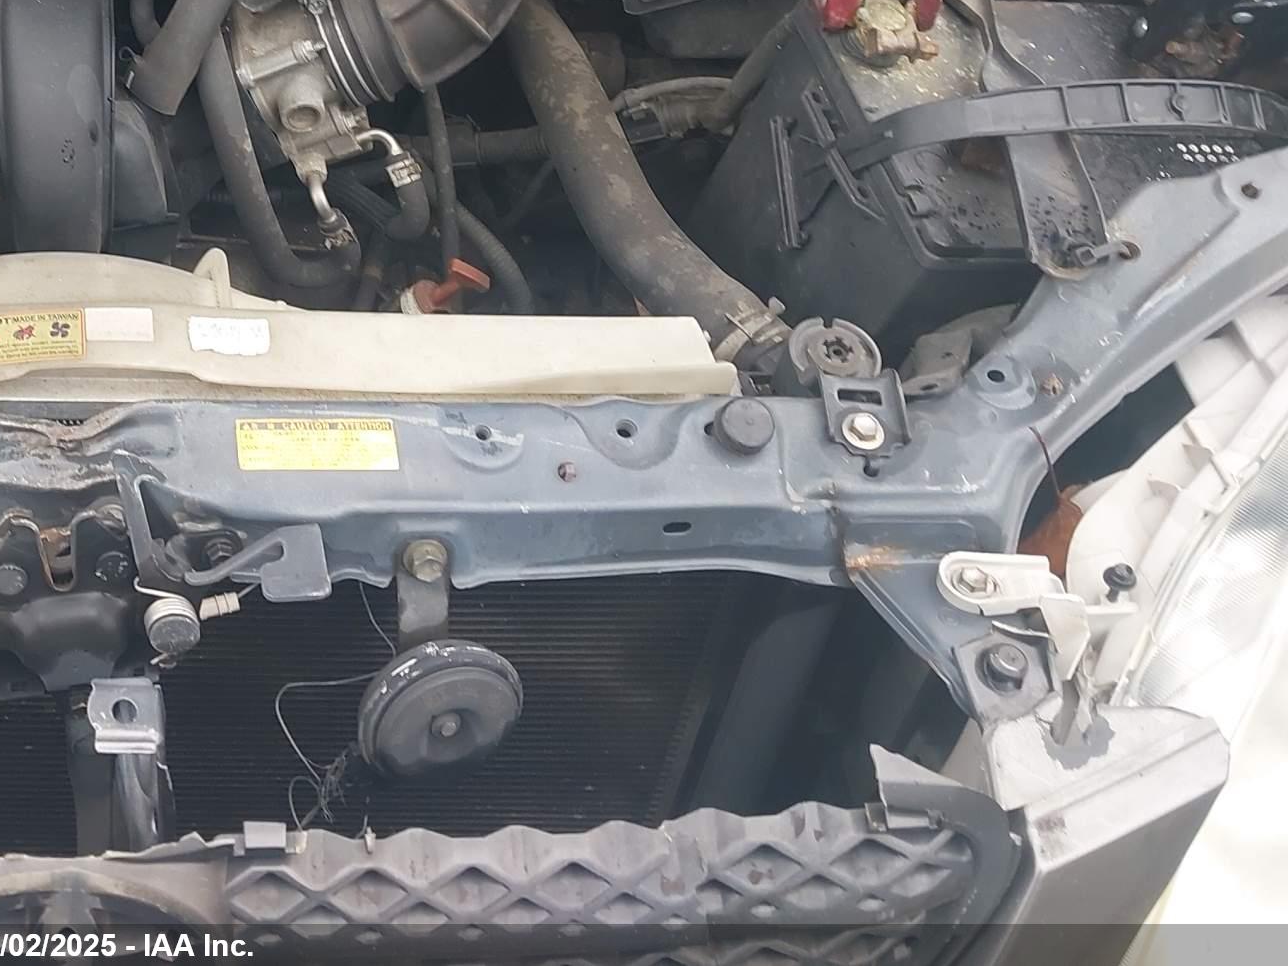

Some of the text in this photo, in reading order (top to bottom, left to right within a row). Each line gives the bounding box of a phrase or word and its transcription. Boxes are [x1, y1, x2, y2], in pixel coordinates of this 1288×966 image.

[12, 314, 37, 323] MADE
[37, 314, 46, 322] IN
[47, 313, 79, 321] TAIWAN
[282, 421, 330, 431] CAUTION
[336, 421, 391, 431] ATTENTION
